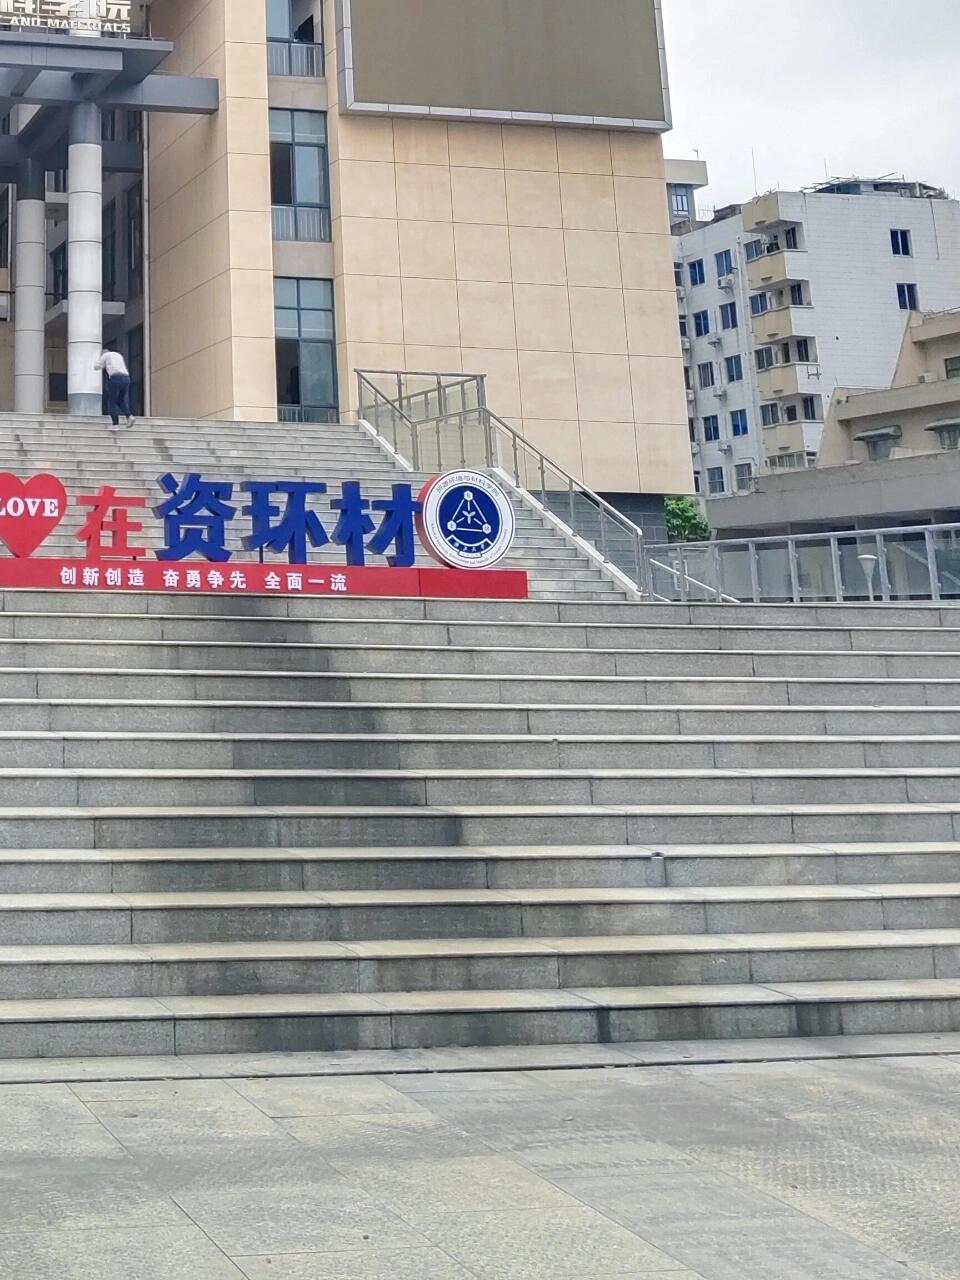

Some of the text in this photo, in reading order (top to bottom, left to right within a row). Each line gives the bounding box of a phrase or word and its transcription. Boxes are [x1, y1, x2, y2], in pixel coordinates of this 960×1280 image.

[10, 15, 41, 27] AND
[60, 566, 348, 591] 创新创造 奋勇争先 全面一流
